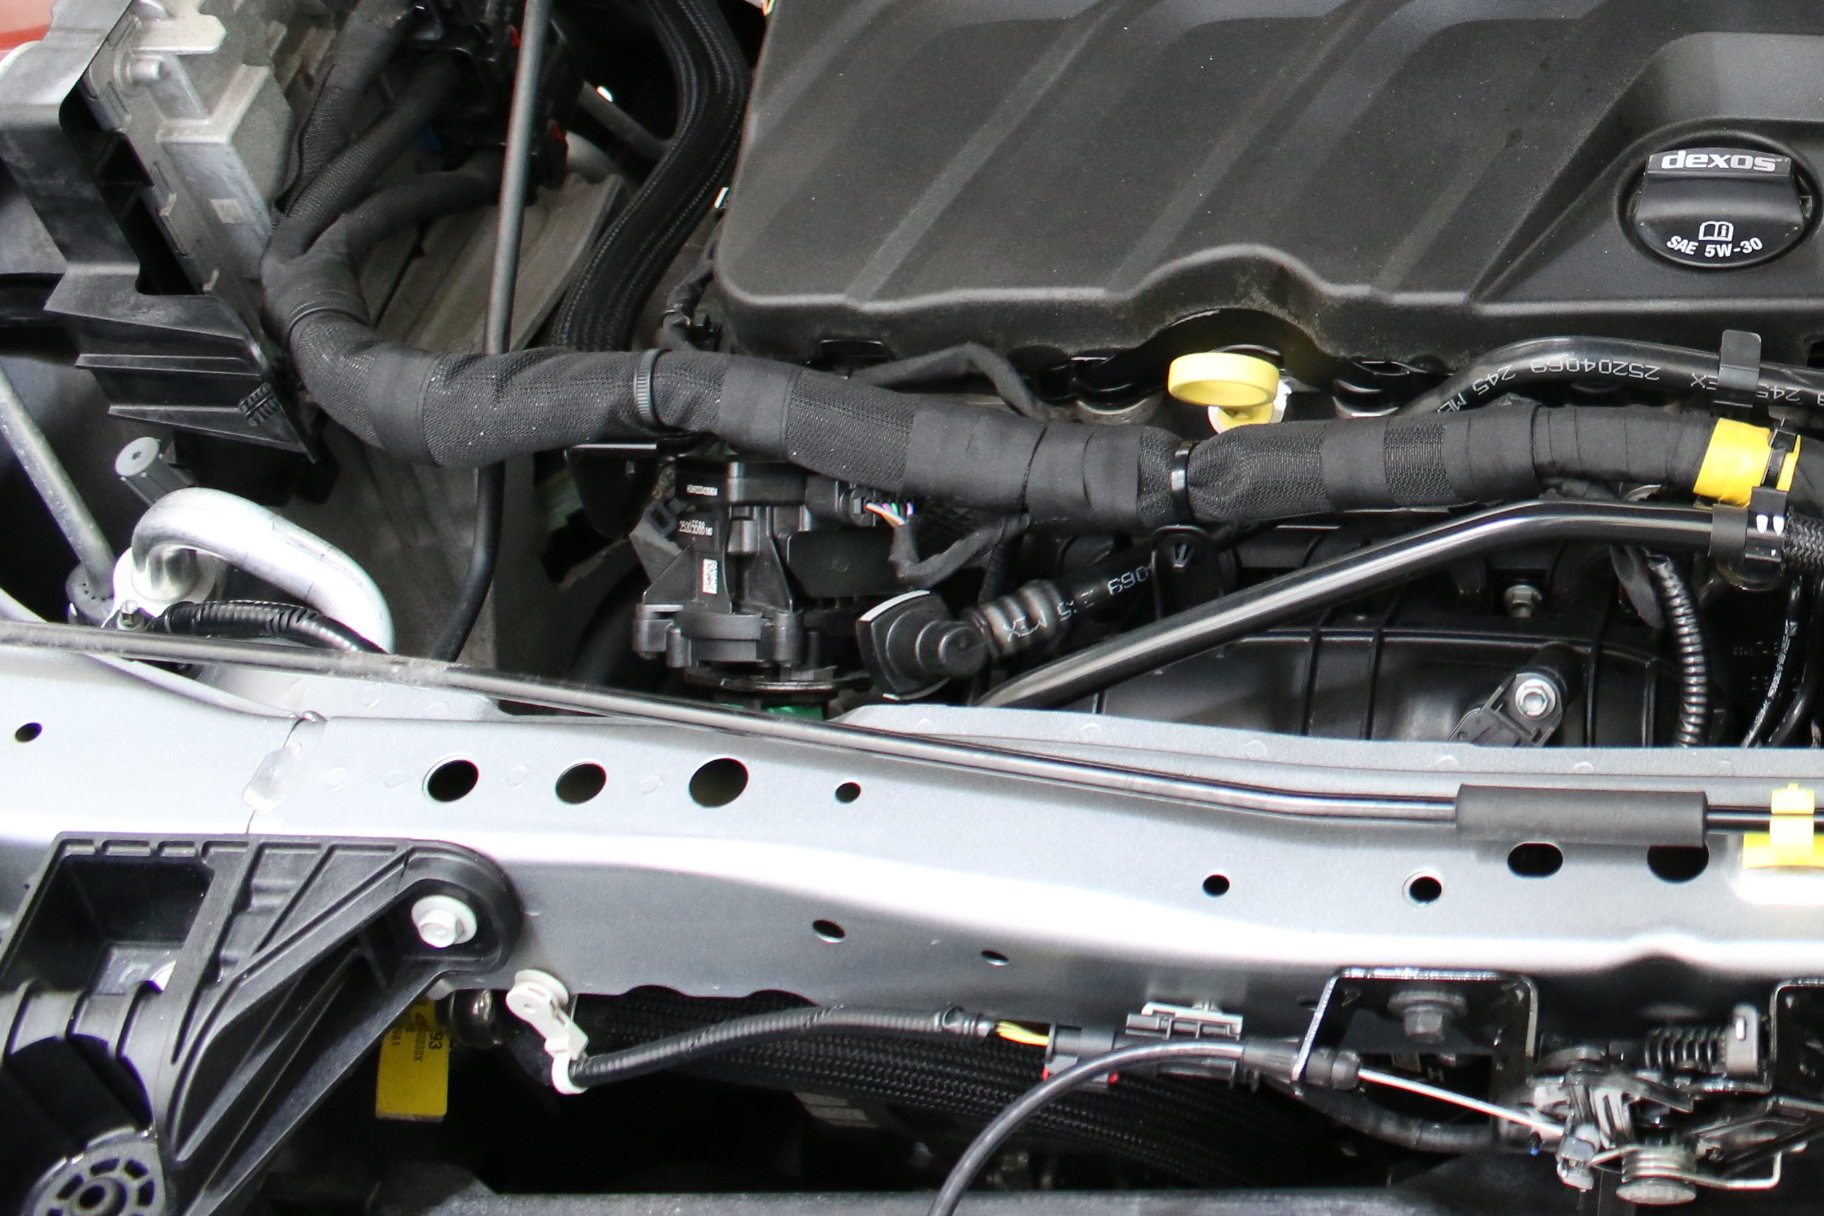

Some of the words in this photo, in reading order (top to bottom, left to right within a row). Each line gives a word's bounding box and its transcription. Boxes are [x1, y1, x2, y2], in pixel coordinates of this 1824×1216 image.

[1661, 150, 1777, 173] dexos
[1666, 235, 1699, 256] SAE
[1704, 236, 1763, 259] 5W-30
[1471, 363, 1517, 397] 245
[1529, 355, 1662, 382] 25204069
[1435, 391, 1467, 415] ME
